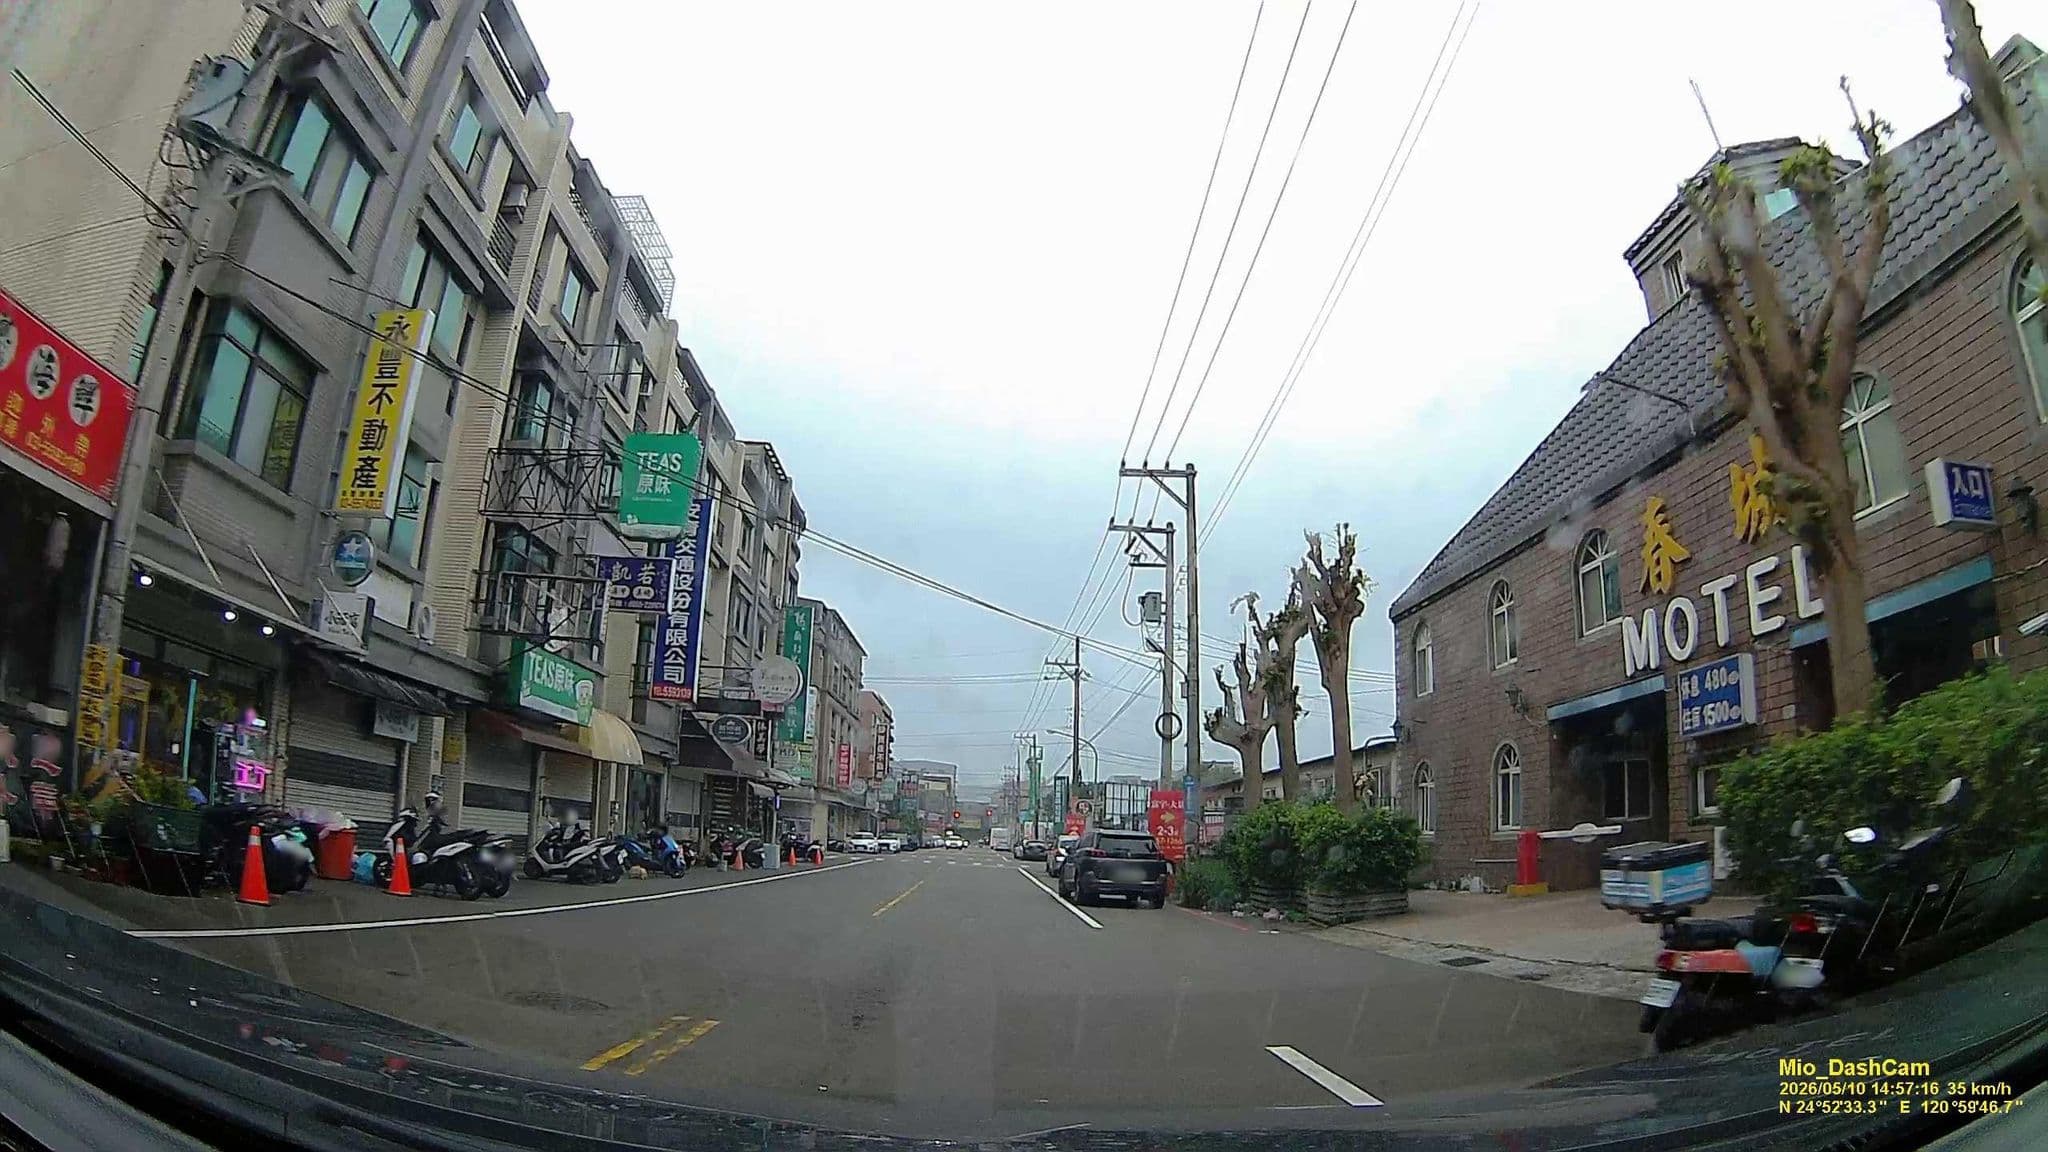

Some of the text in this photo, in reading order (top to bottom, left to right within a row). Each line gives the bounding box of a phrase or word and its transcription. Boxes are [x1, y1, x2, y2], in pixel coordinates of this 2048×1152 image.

[636, 451, 683, 473] TEAS
[635, 475, 672, 495] 原味
[1952, 467, 1985, 500] 入口
[1622, 546, 1826, 678] MOTEL
[1705, 666, 1728, 692] 480
[1703, 700, 1730, 726] 1500
